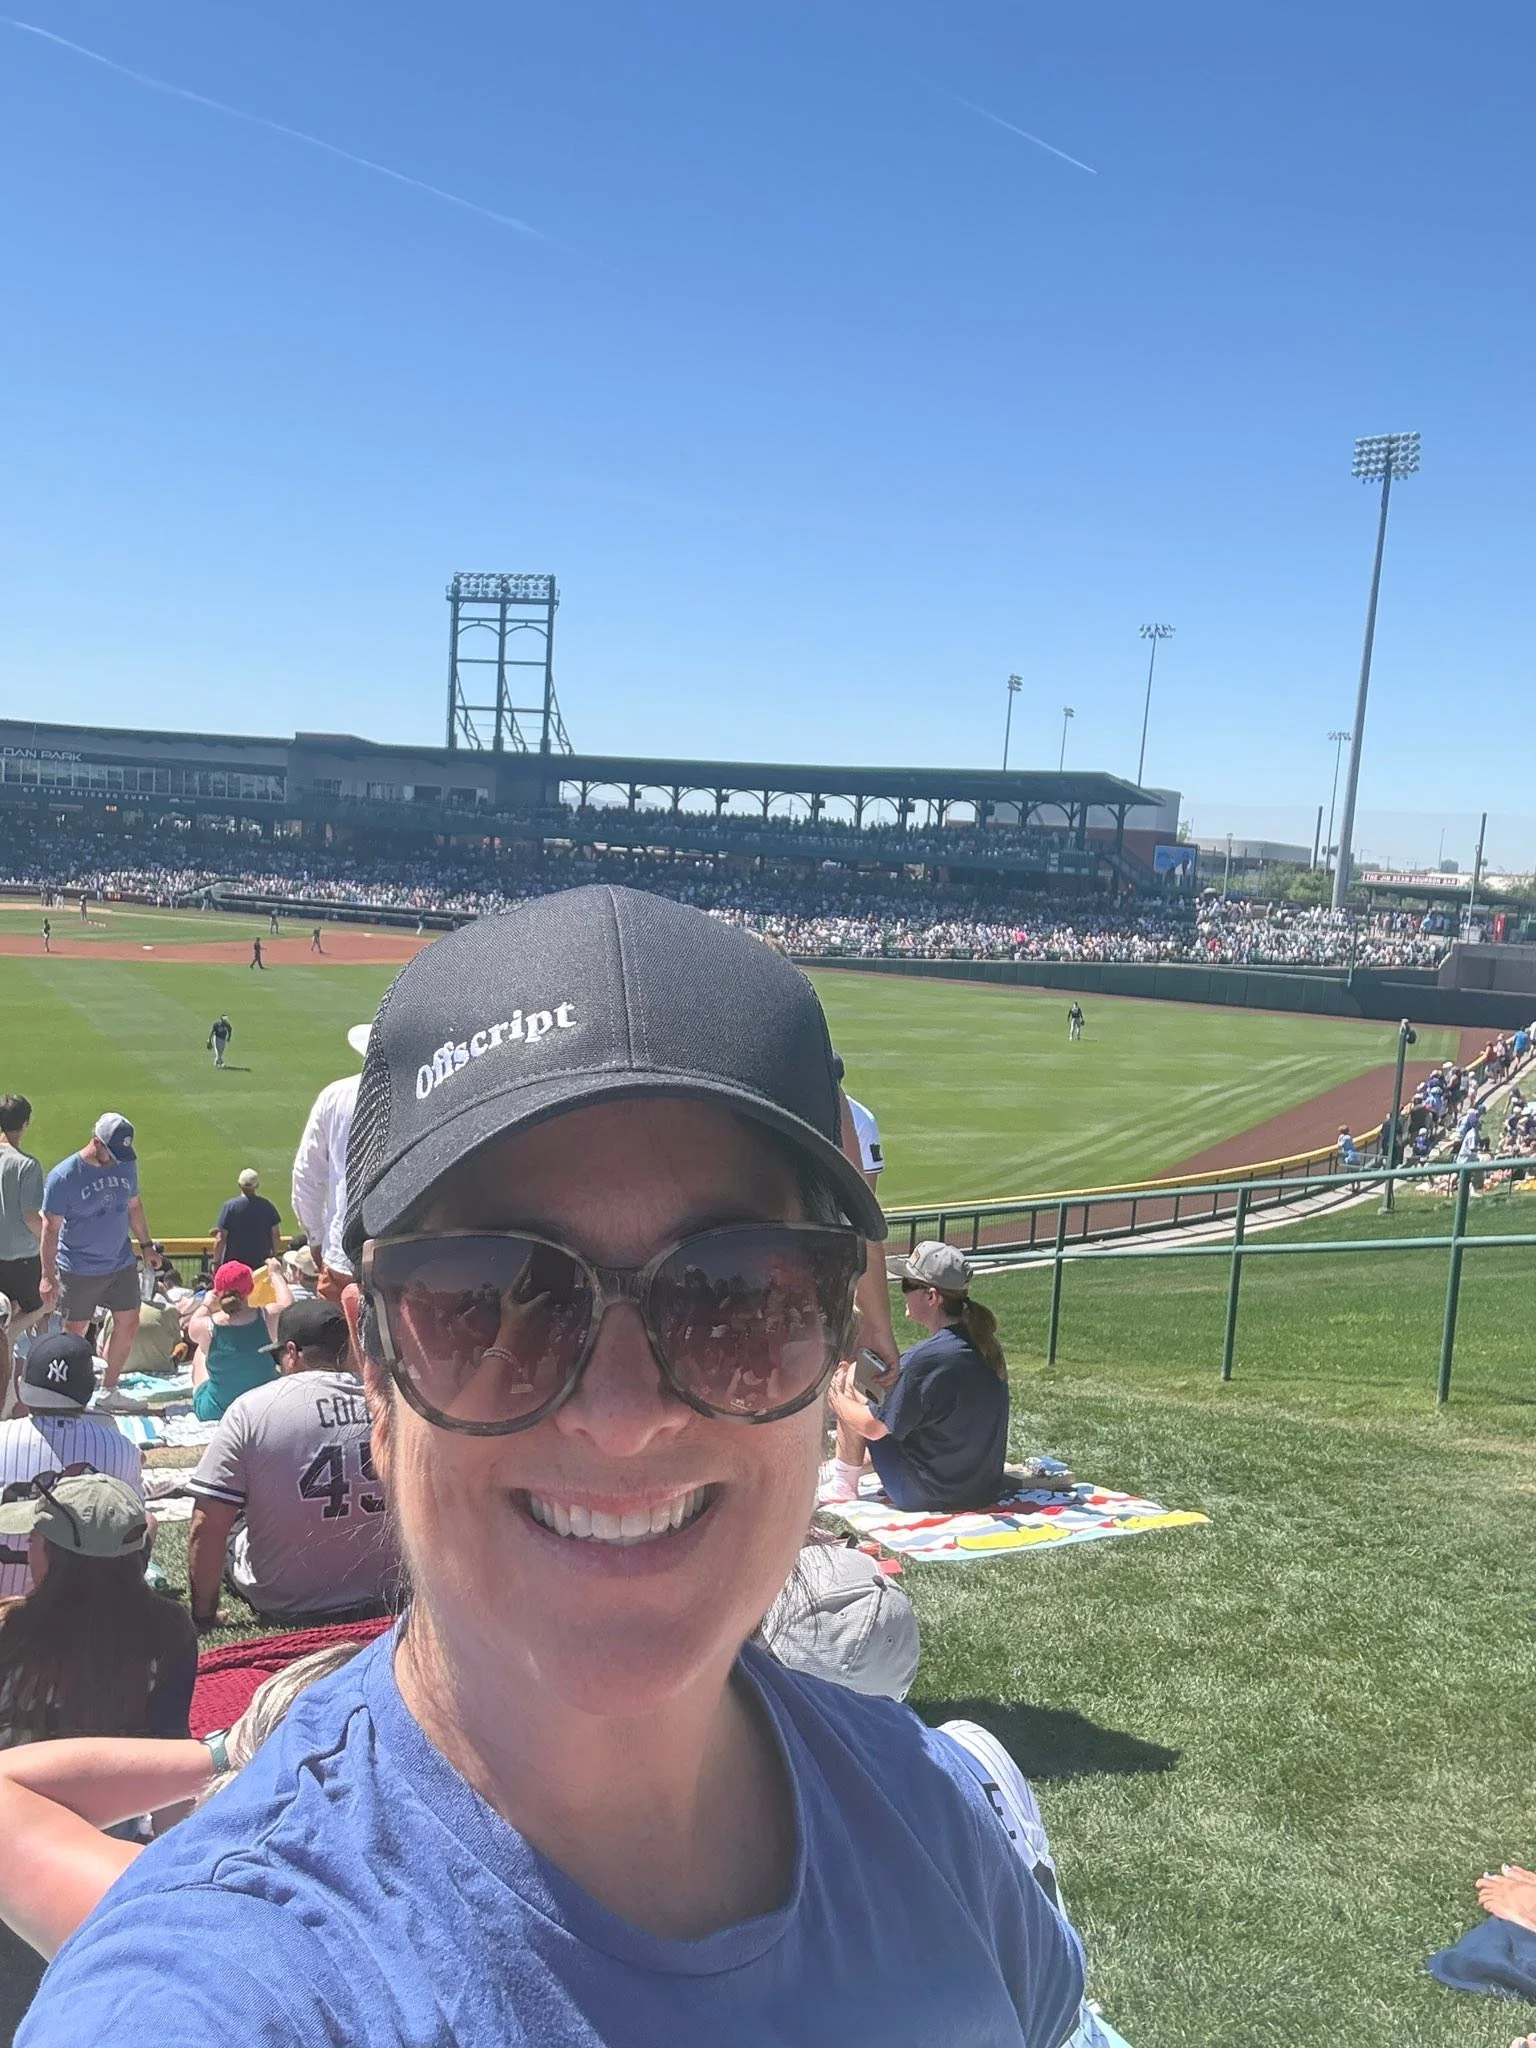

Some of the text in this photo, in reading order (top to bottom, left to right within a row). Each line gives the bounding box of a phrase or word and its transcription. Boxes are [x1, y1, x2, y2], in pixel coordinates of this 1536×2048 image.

[41, 750, 82, 761] PARK
[416, 1001, 577, 1099] Offscript
[81, 1176, 131, 1200] CUBS
